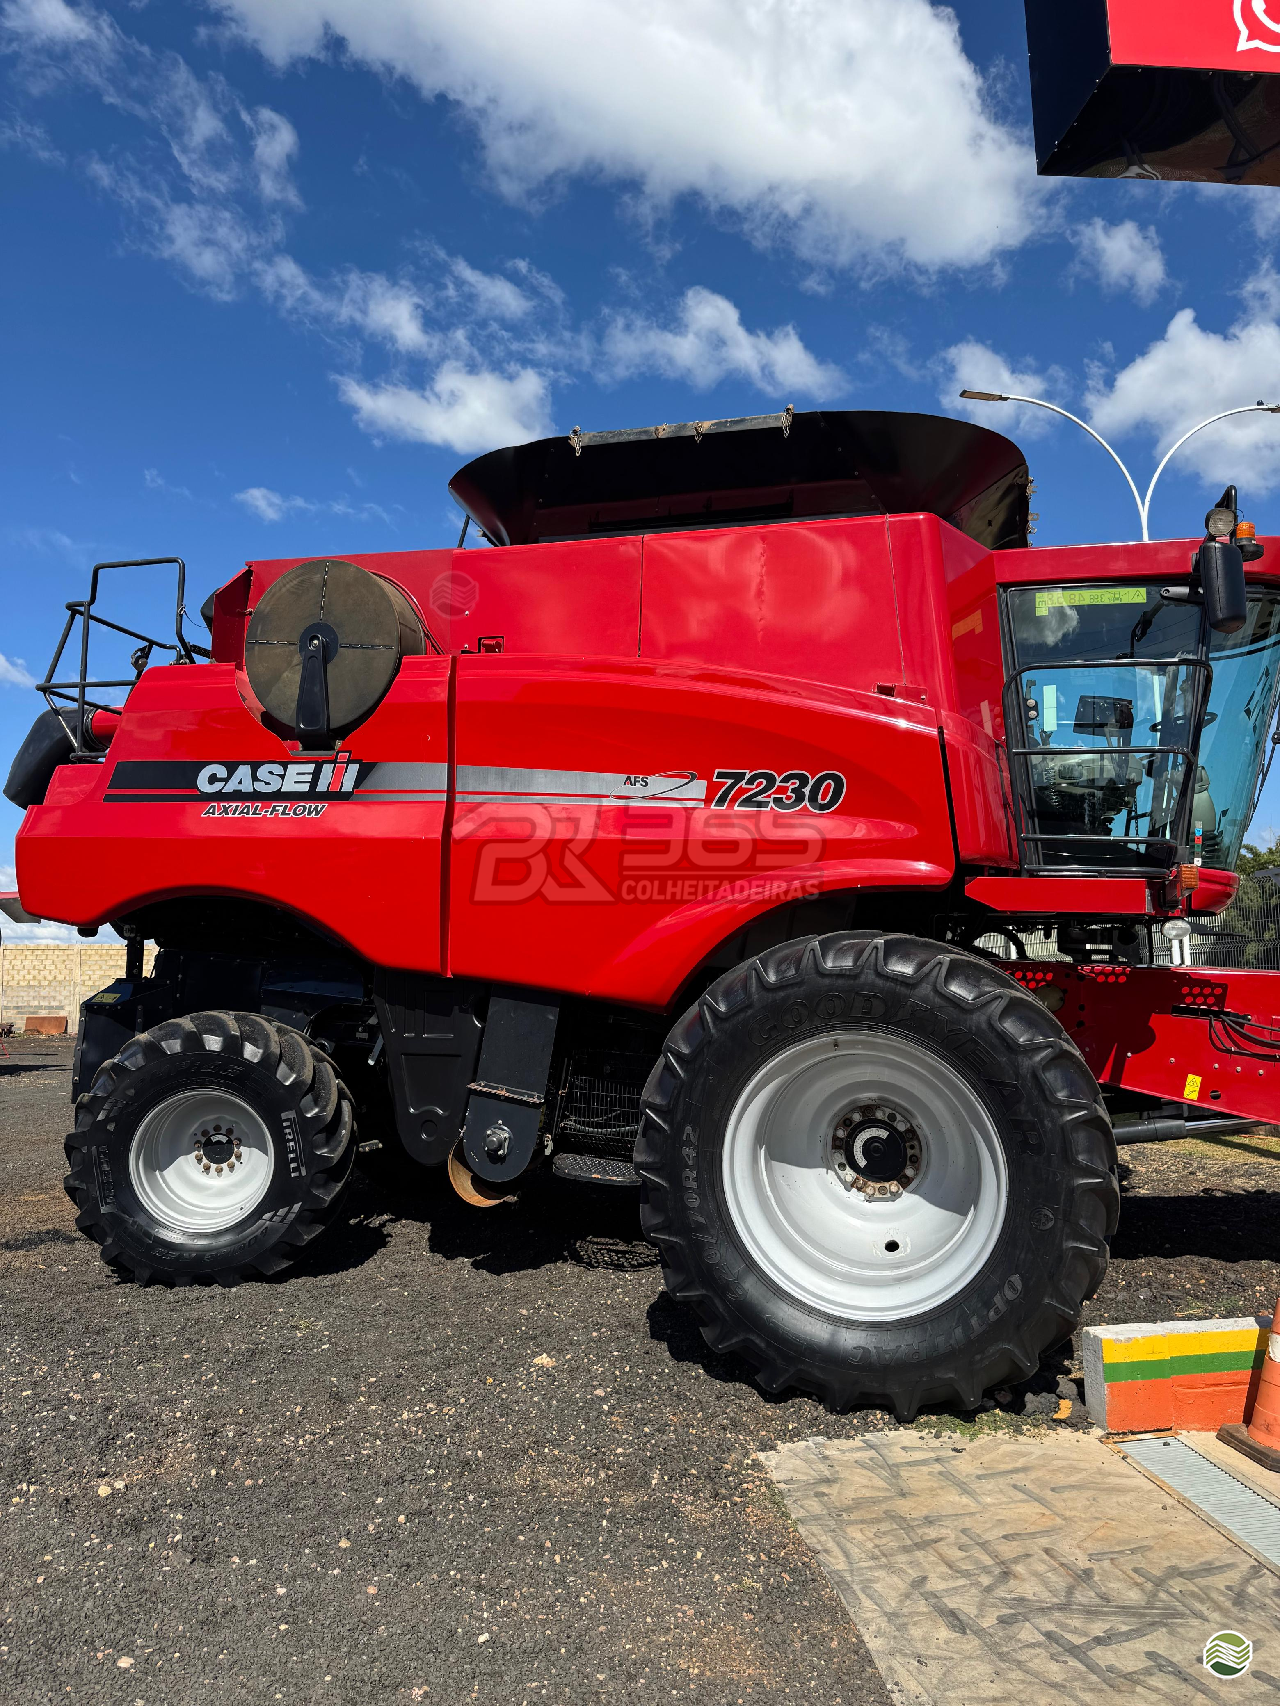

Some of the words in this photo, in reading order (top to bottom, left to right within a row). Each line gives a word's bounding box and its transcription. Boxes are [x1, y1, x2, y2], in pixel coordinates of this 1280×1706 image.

[196, 763, 316, 793] CASE
[623, 774, 650, 789] AFS
[711, 768, 847, 814] 7230
[201, 803, 328, 818] AXIAL-FLOW
[746, 991, 1047, 1157] GOODYEAR
[280, 1109, 308, 1179] PIRELLI
[846, 1272, 1024, 1367] OPTITRAC
